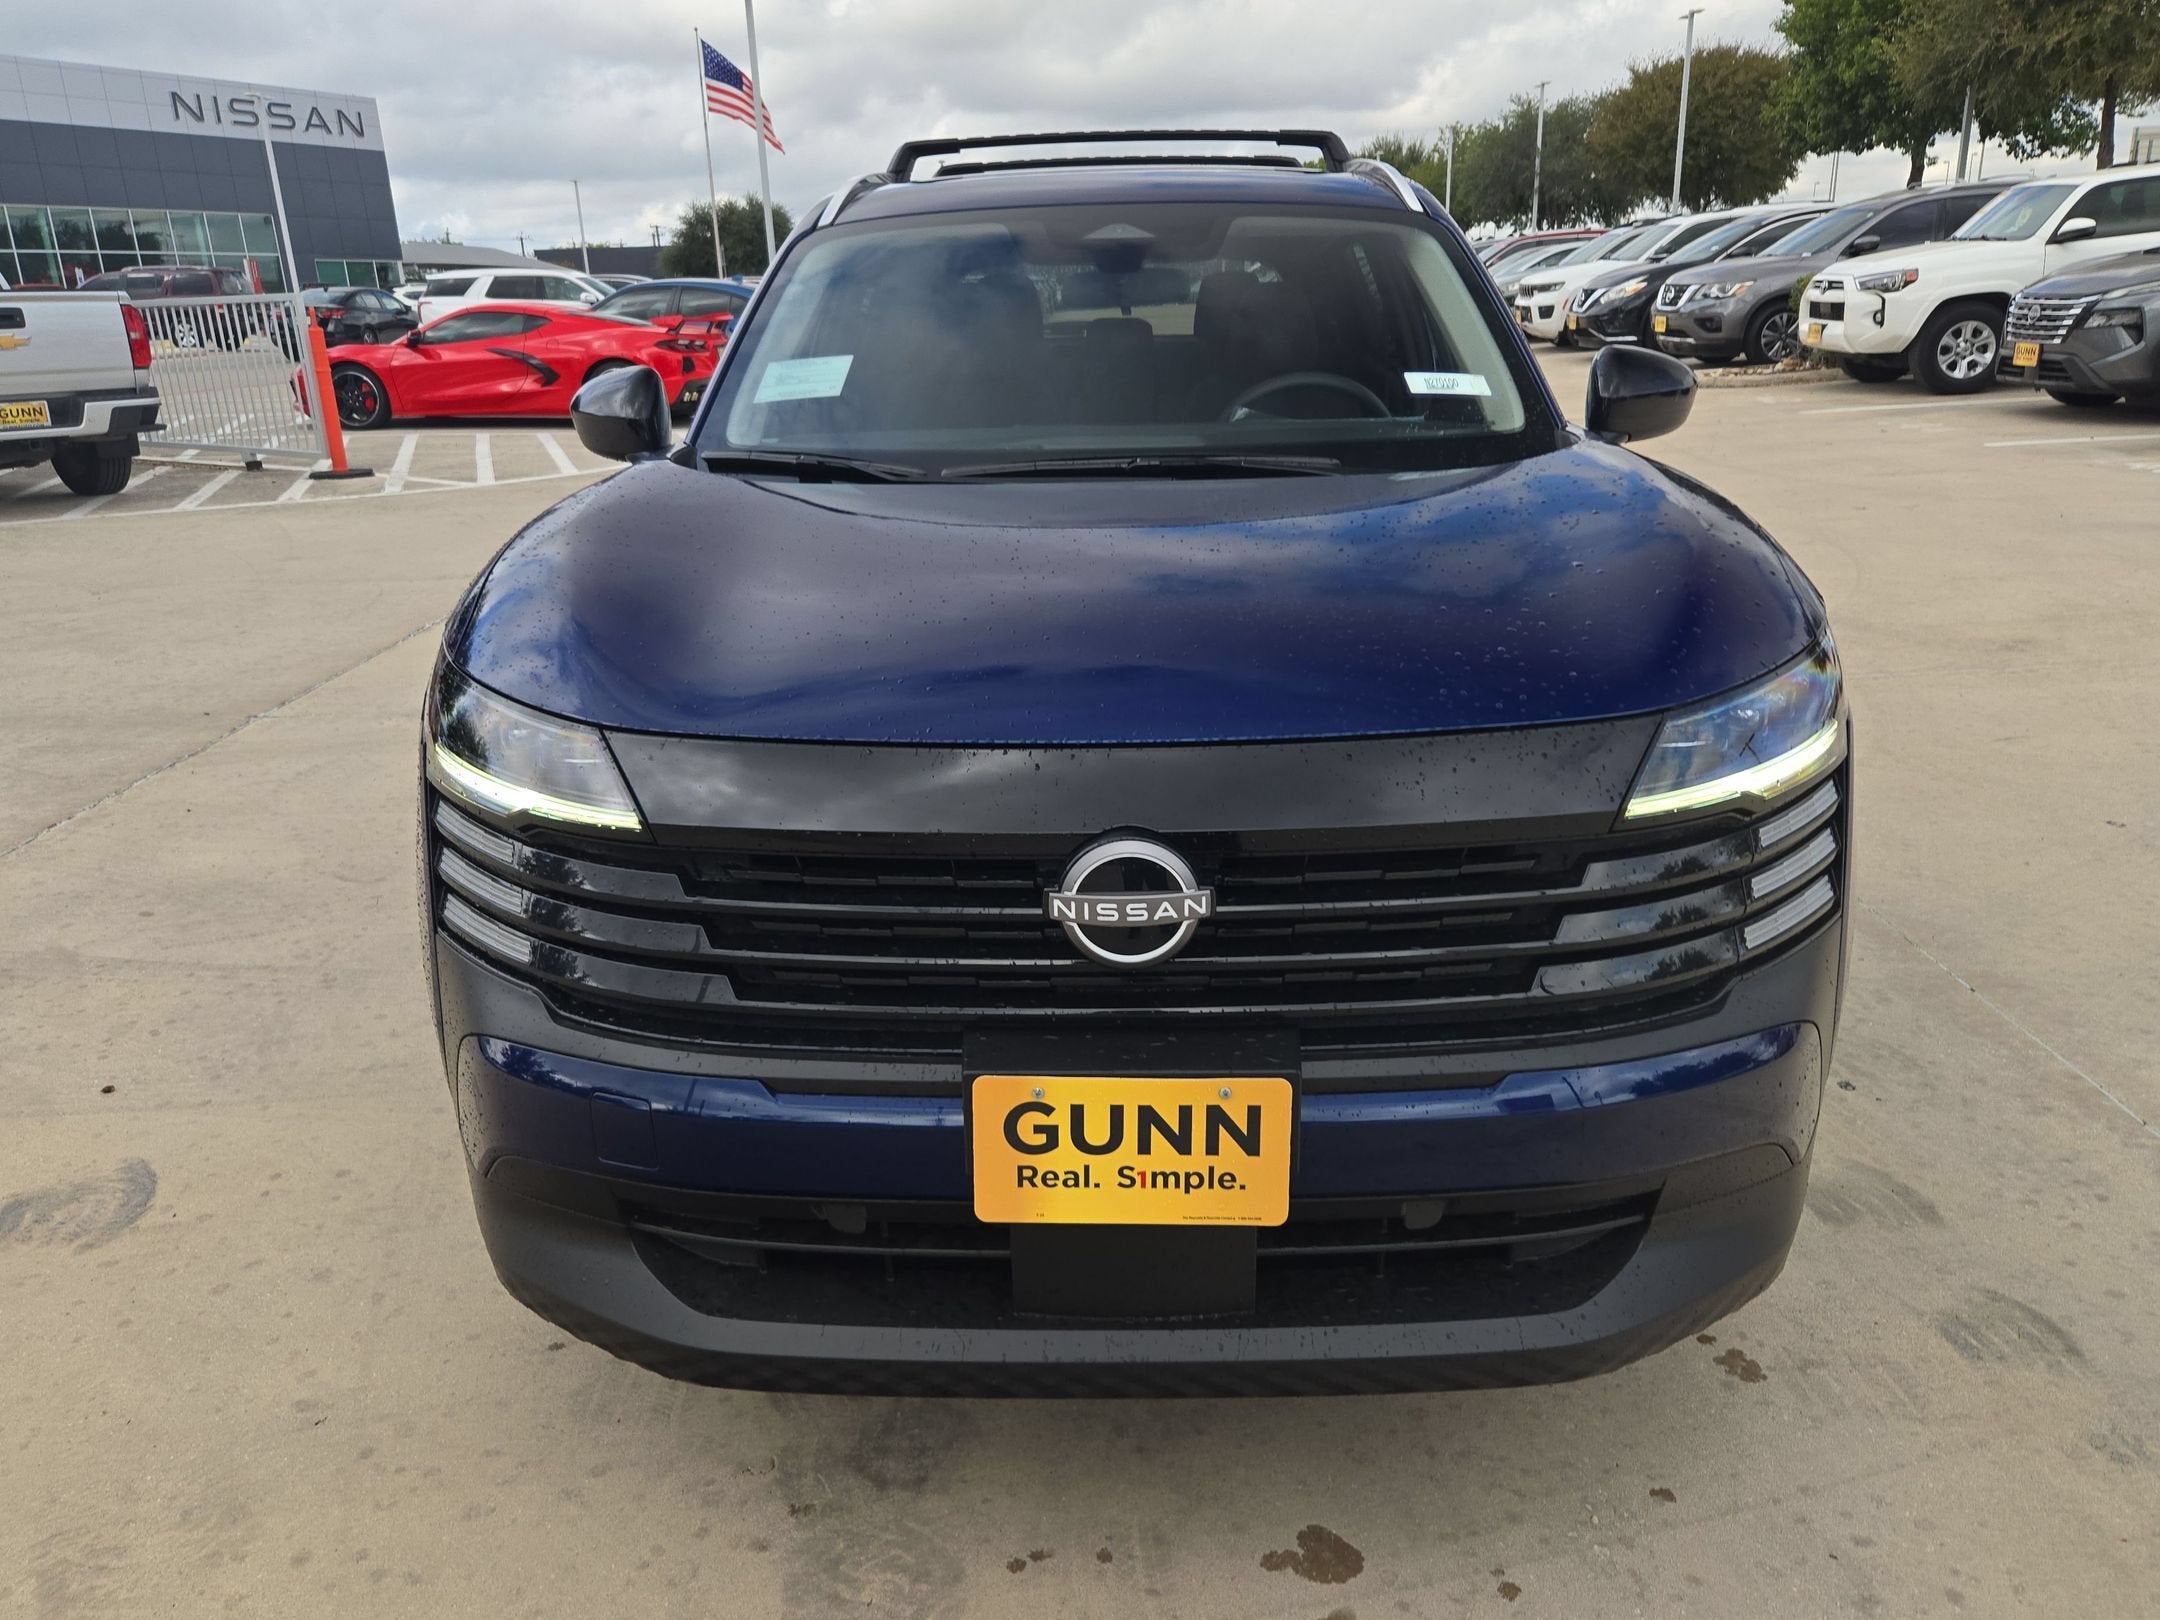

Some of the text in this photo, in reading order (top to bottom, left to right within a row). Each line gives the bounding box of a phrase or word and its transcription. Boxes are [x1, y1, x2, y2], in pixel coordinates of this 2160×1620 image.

[170, 91, 365, 138] NISSAN
[0, 406, 43, 419] GUNN
[1053, 896, 1207, 922] NISSAN
[1003, 1101, 1262, 1157] GUNN
[1016, 1164, 1100, 1189] Real.
